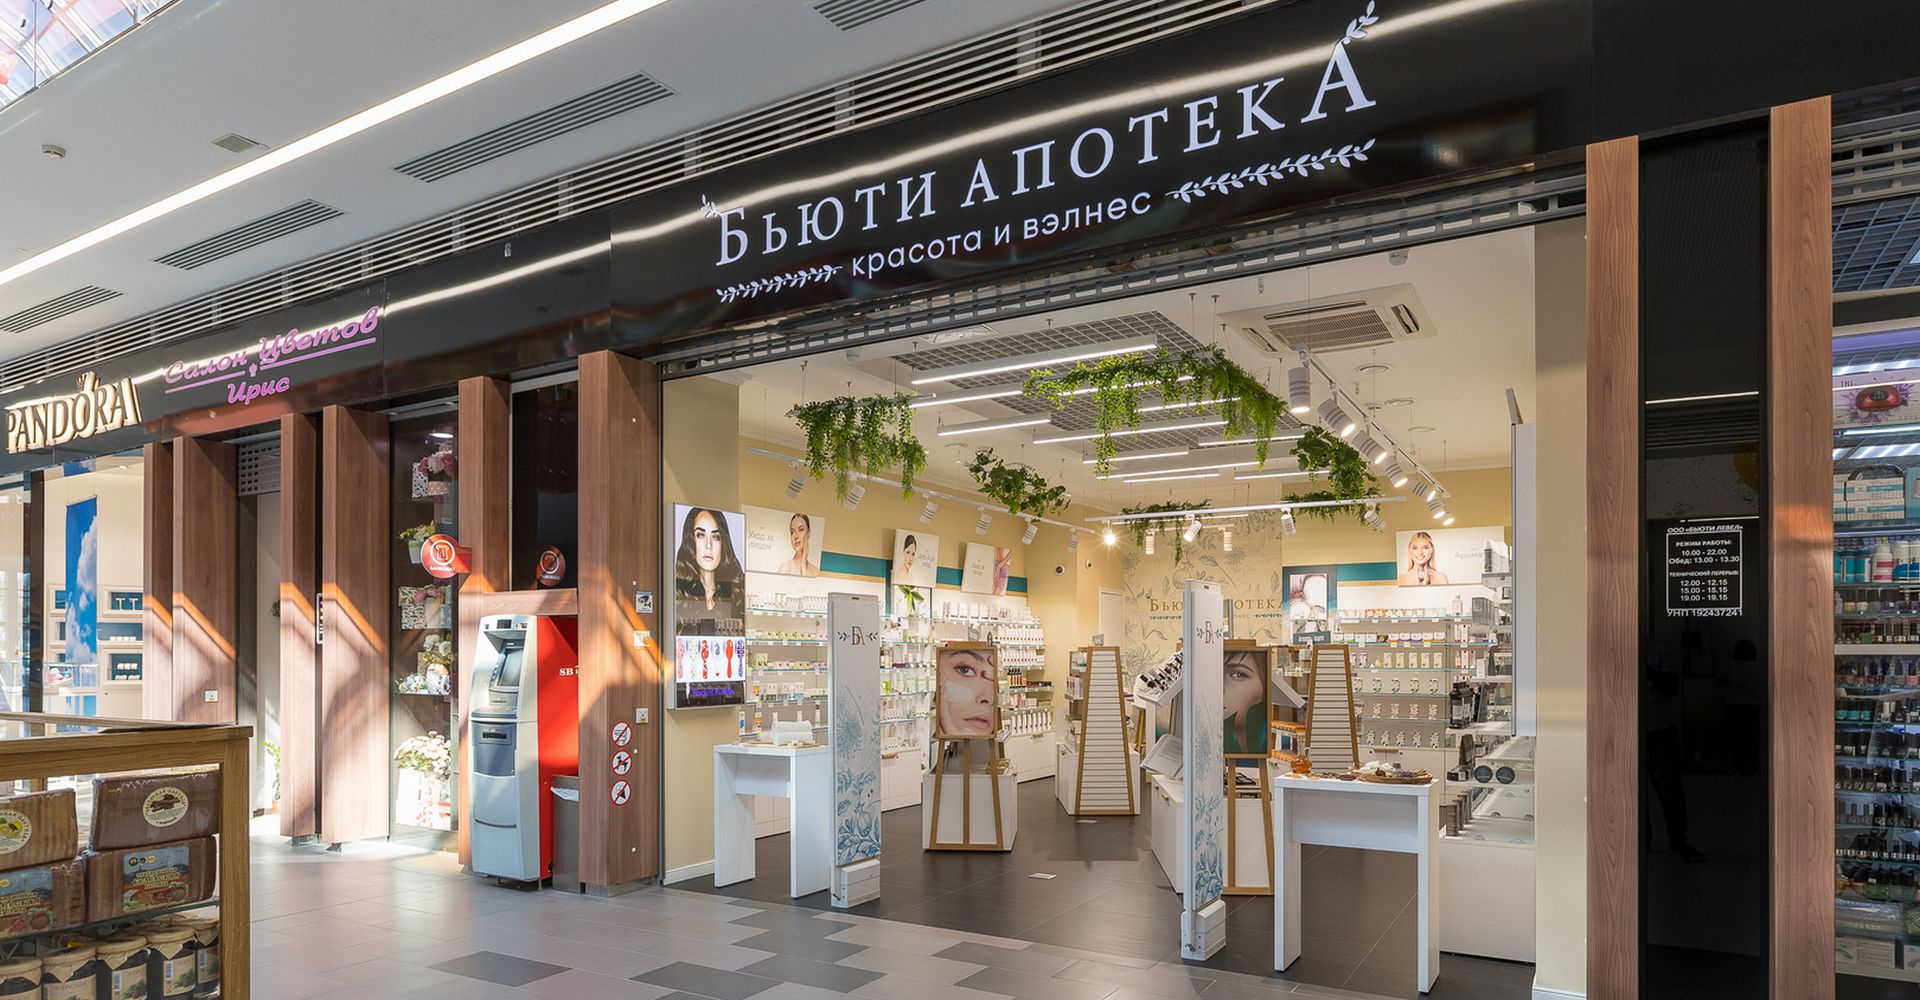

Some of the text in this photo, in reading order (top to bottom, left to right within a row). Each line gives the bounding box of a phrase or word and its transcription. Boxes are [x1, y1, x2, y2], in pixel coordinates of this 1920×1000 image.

[715, 42, 1376, 267] БЬЮТИ АПОТЕКА
[851, 191, 1151, 280] красота и вэлнес
[163, 306, 381, 384] Салон Цветов
[6, 375, 142, 453] PANDORA
[227, 378, 290, 405] Ирис
[1692, 609, 1743, 617] 192437241
